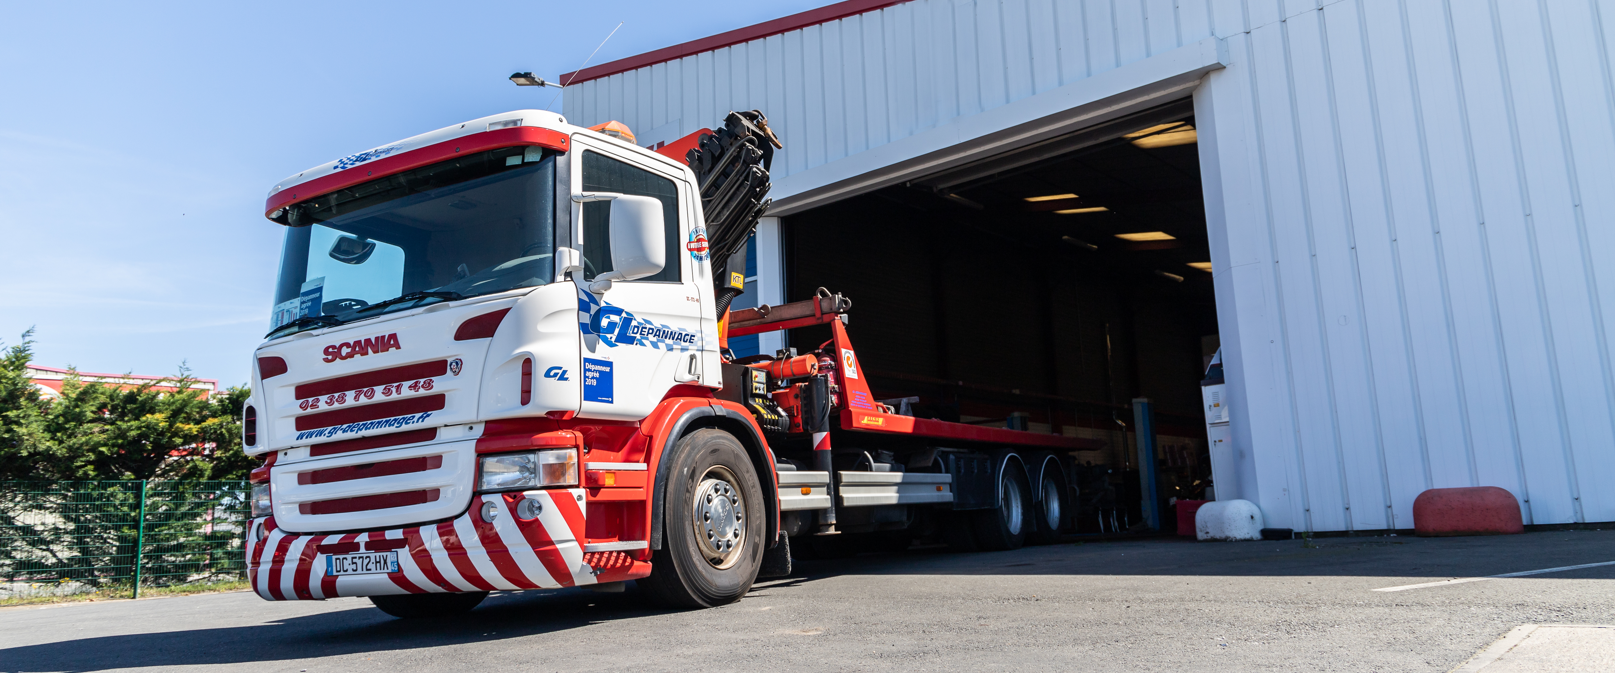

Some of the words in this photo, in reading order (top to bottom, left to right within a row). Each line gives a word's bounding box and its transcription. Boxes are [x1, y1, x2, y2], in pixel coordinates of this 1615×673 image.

[631, 323, 696, 344] DÉPANNAGE
[322, 332, 401, 363] SCANIA
[585, 362, 611, 372] Dépanneur
[585, 378, 597, 386] 2019
[299, 397, 321, 411] 02
[325, 392, 347, 407] 38
[353, 387, 376, 402] 70
[381, 382, 403, 397] 51
[407, 378, 434, 393] 48
[295, 412, 433, 440] www.gl-depannage.fr
[334, 554, 389, 573] DC-572-HX
[391, 562, 398, 571] 45
